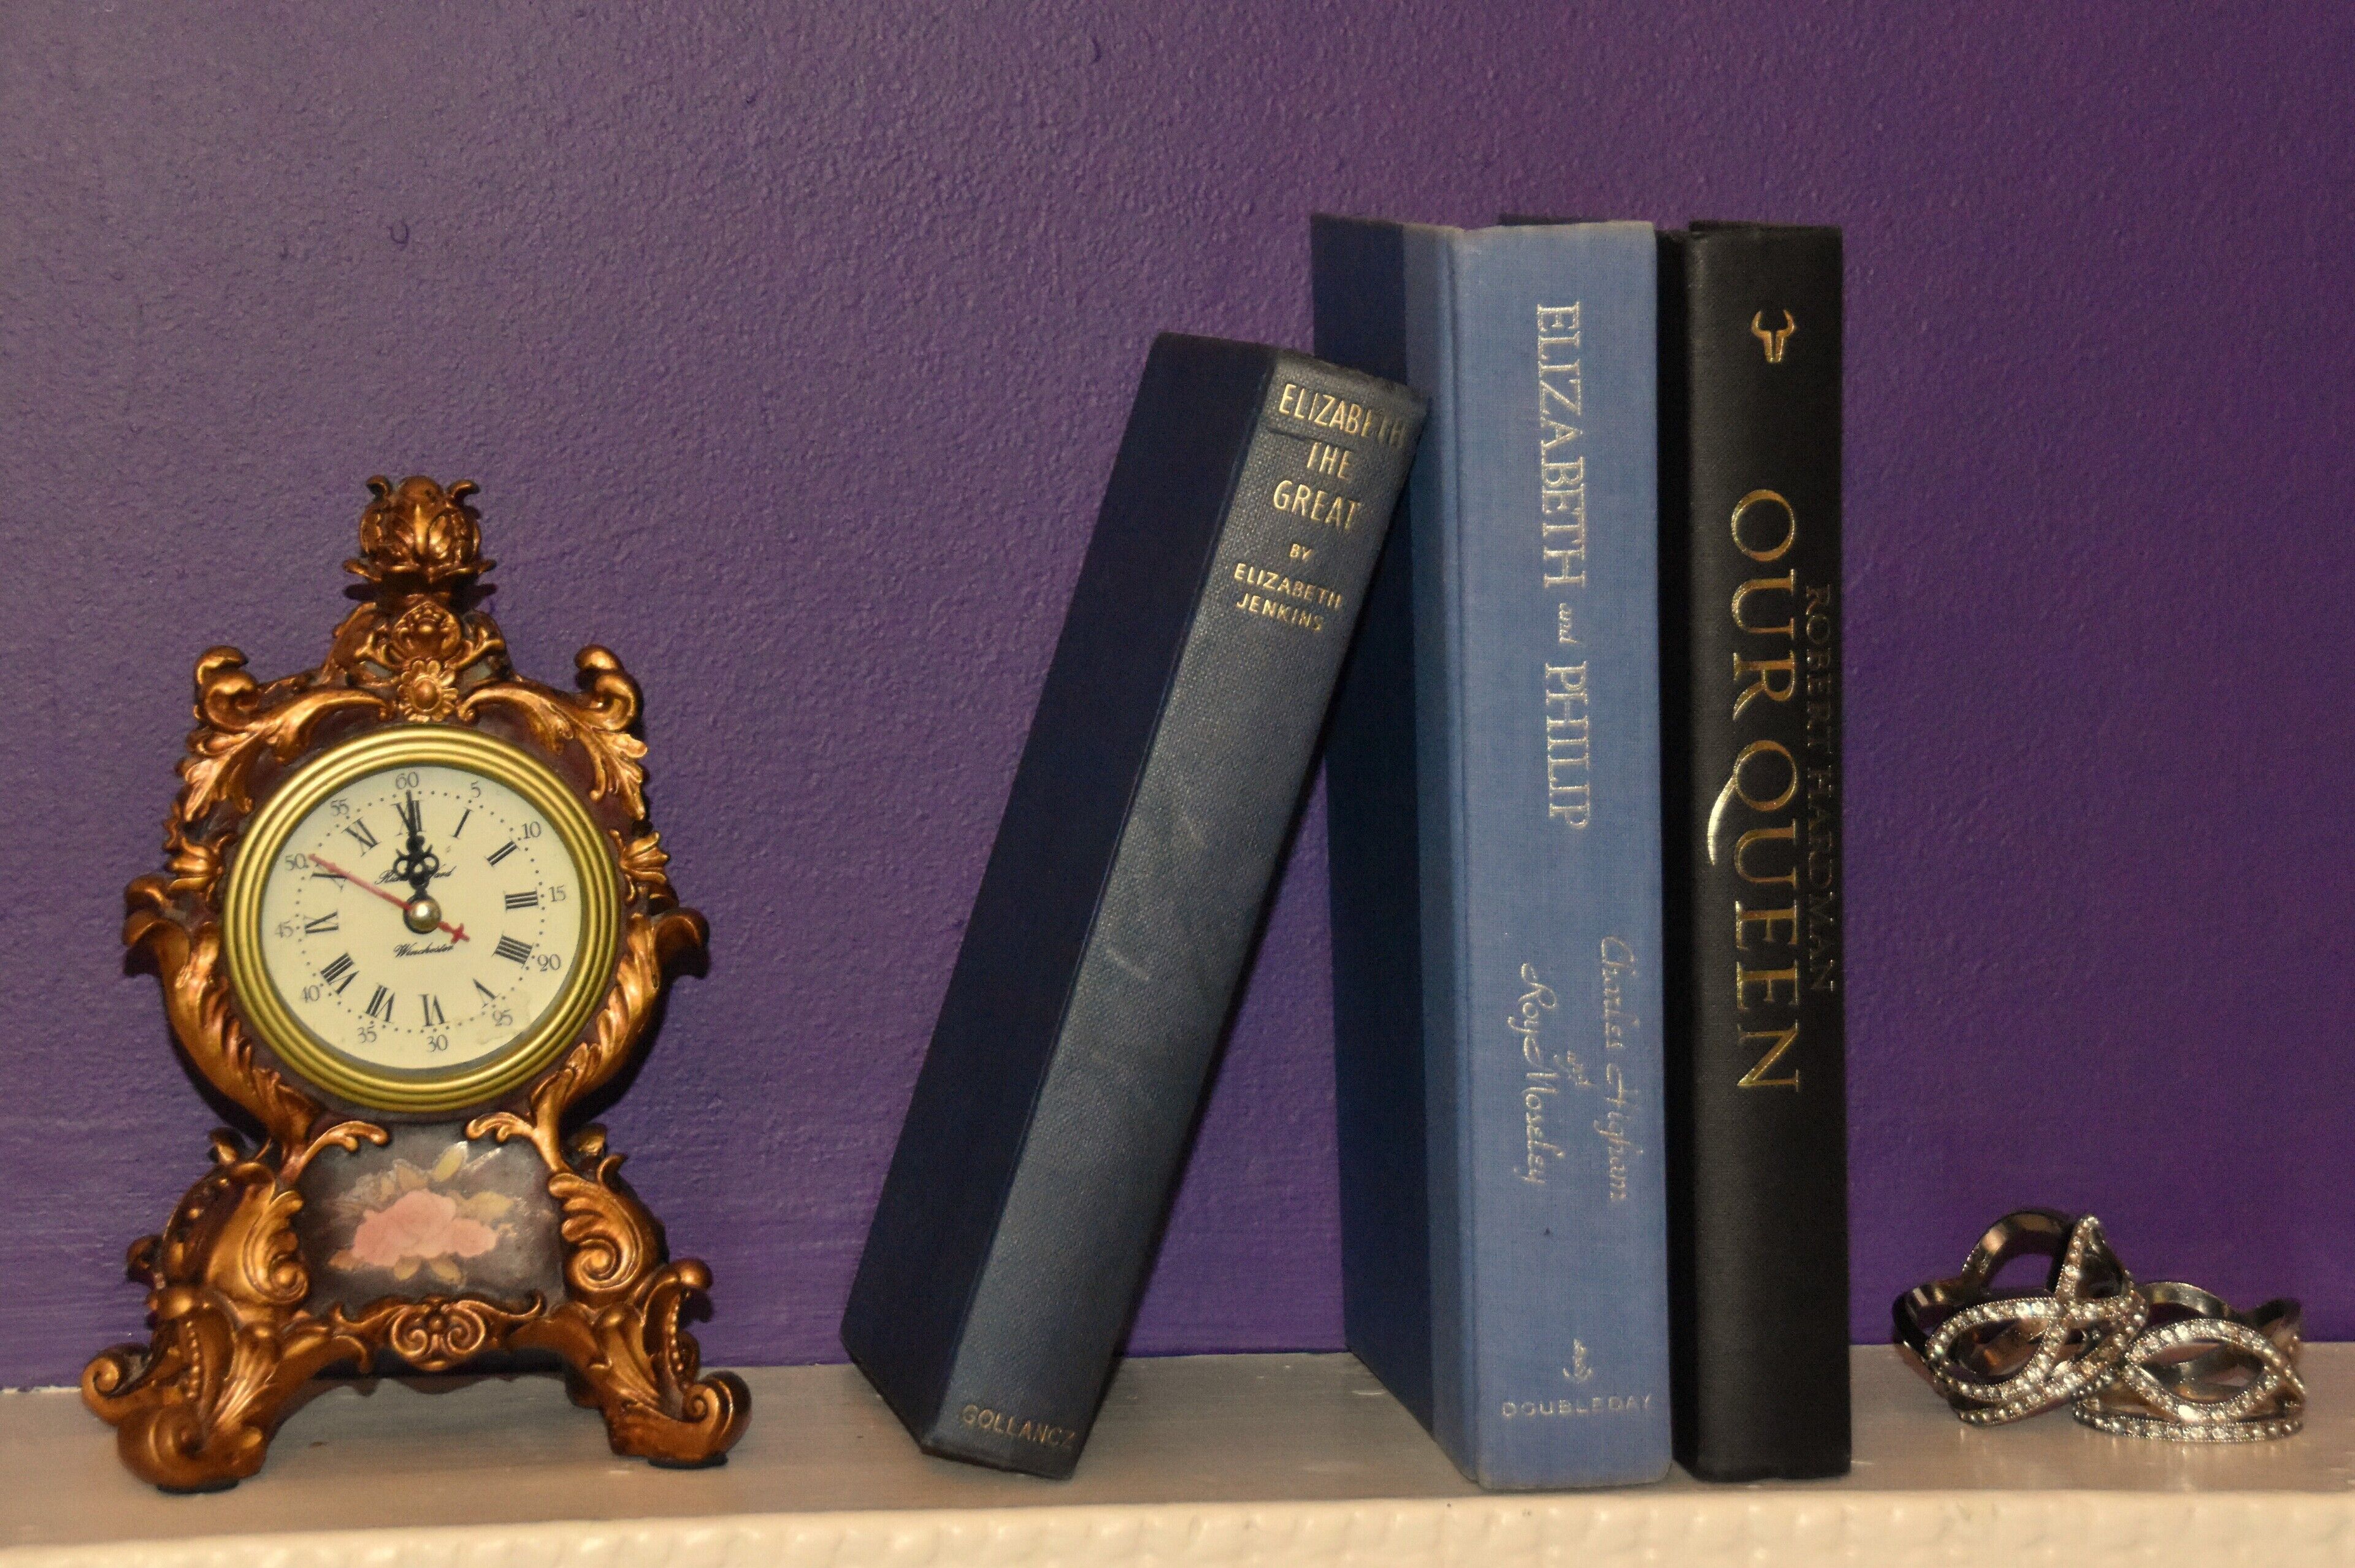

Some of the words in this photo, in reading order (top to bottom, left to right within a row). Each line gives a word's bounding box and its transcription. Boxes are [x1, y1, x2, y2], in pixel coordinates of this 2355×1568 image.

[1537, 302, 1587, 587] ELIZABETH
[1306, 442, 1354, 481] THE
[1273, 480, 1363, 532] GREAT
[1289, 543, 1314, 561] BY
[1234, 563, 1344, 611] ELIZABETH
[1236, 593, 1325, 632] JENKINS
[1731, 489, 1796, 721] OUR
[1558, 602, 1577, 646] and
[1806, 583, 1832, 755] ROBERT
[1545, 660, 1590, 830] PHILIP
[396, 771, 419, 790] 60
[470, 781, 481, 798] 5
[330, 798, 350, 816] 55
[450, 807, 473, 838] I
[521, 821, 542, 839] 10
[340, 817, 382, 859] XI
[484, 836, 521, 868] II
[285, 853, 306, 871] 50
[548, 885, 567, 902] 15
[1807, 765, 1834, 993] HARDMAN
[503, 887, 538, 912] III
[275, 920, 294, 938] 45
[303, 908, 339, 936] IX
[1707, 740, 1800, 1093] QUEEN
[537, 954, 561, 972] 20
[301, 985, 320, 1003] 40
[472, 978, 500, 1008] V
[1507, 962, 1558, 1035] Roy
[357, 1023, 377, 1043] 35
[492, 1009, 513, 1027] 25
[427, 1034, 448, 1052] 30
[1513, 1034, 1565, 1185] Moseley
[1502, 1393, 1652, 1420] DOUBLEDAY
[962, 1404, 1076, 1448] GOLLANCZ
